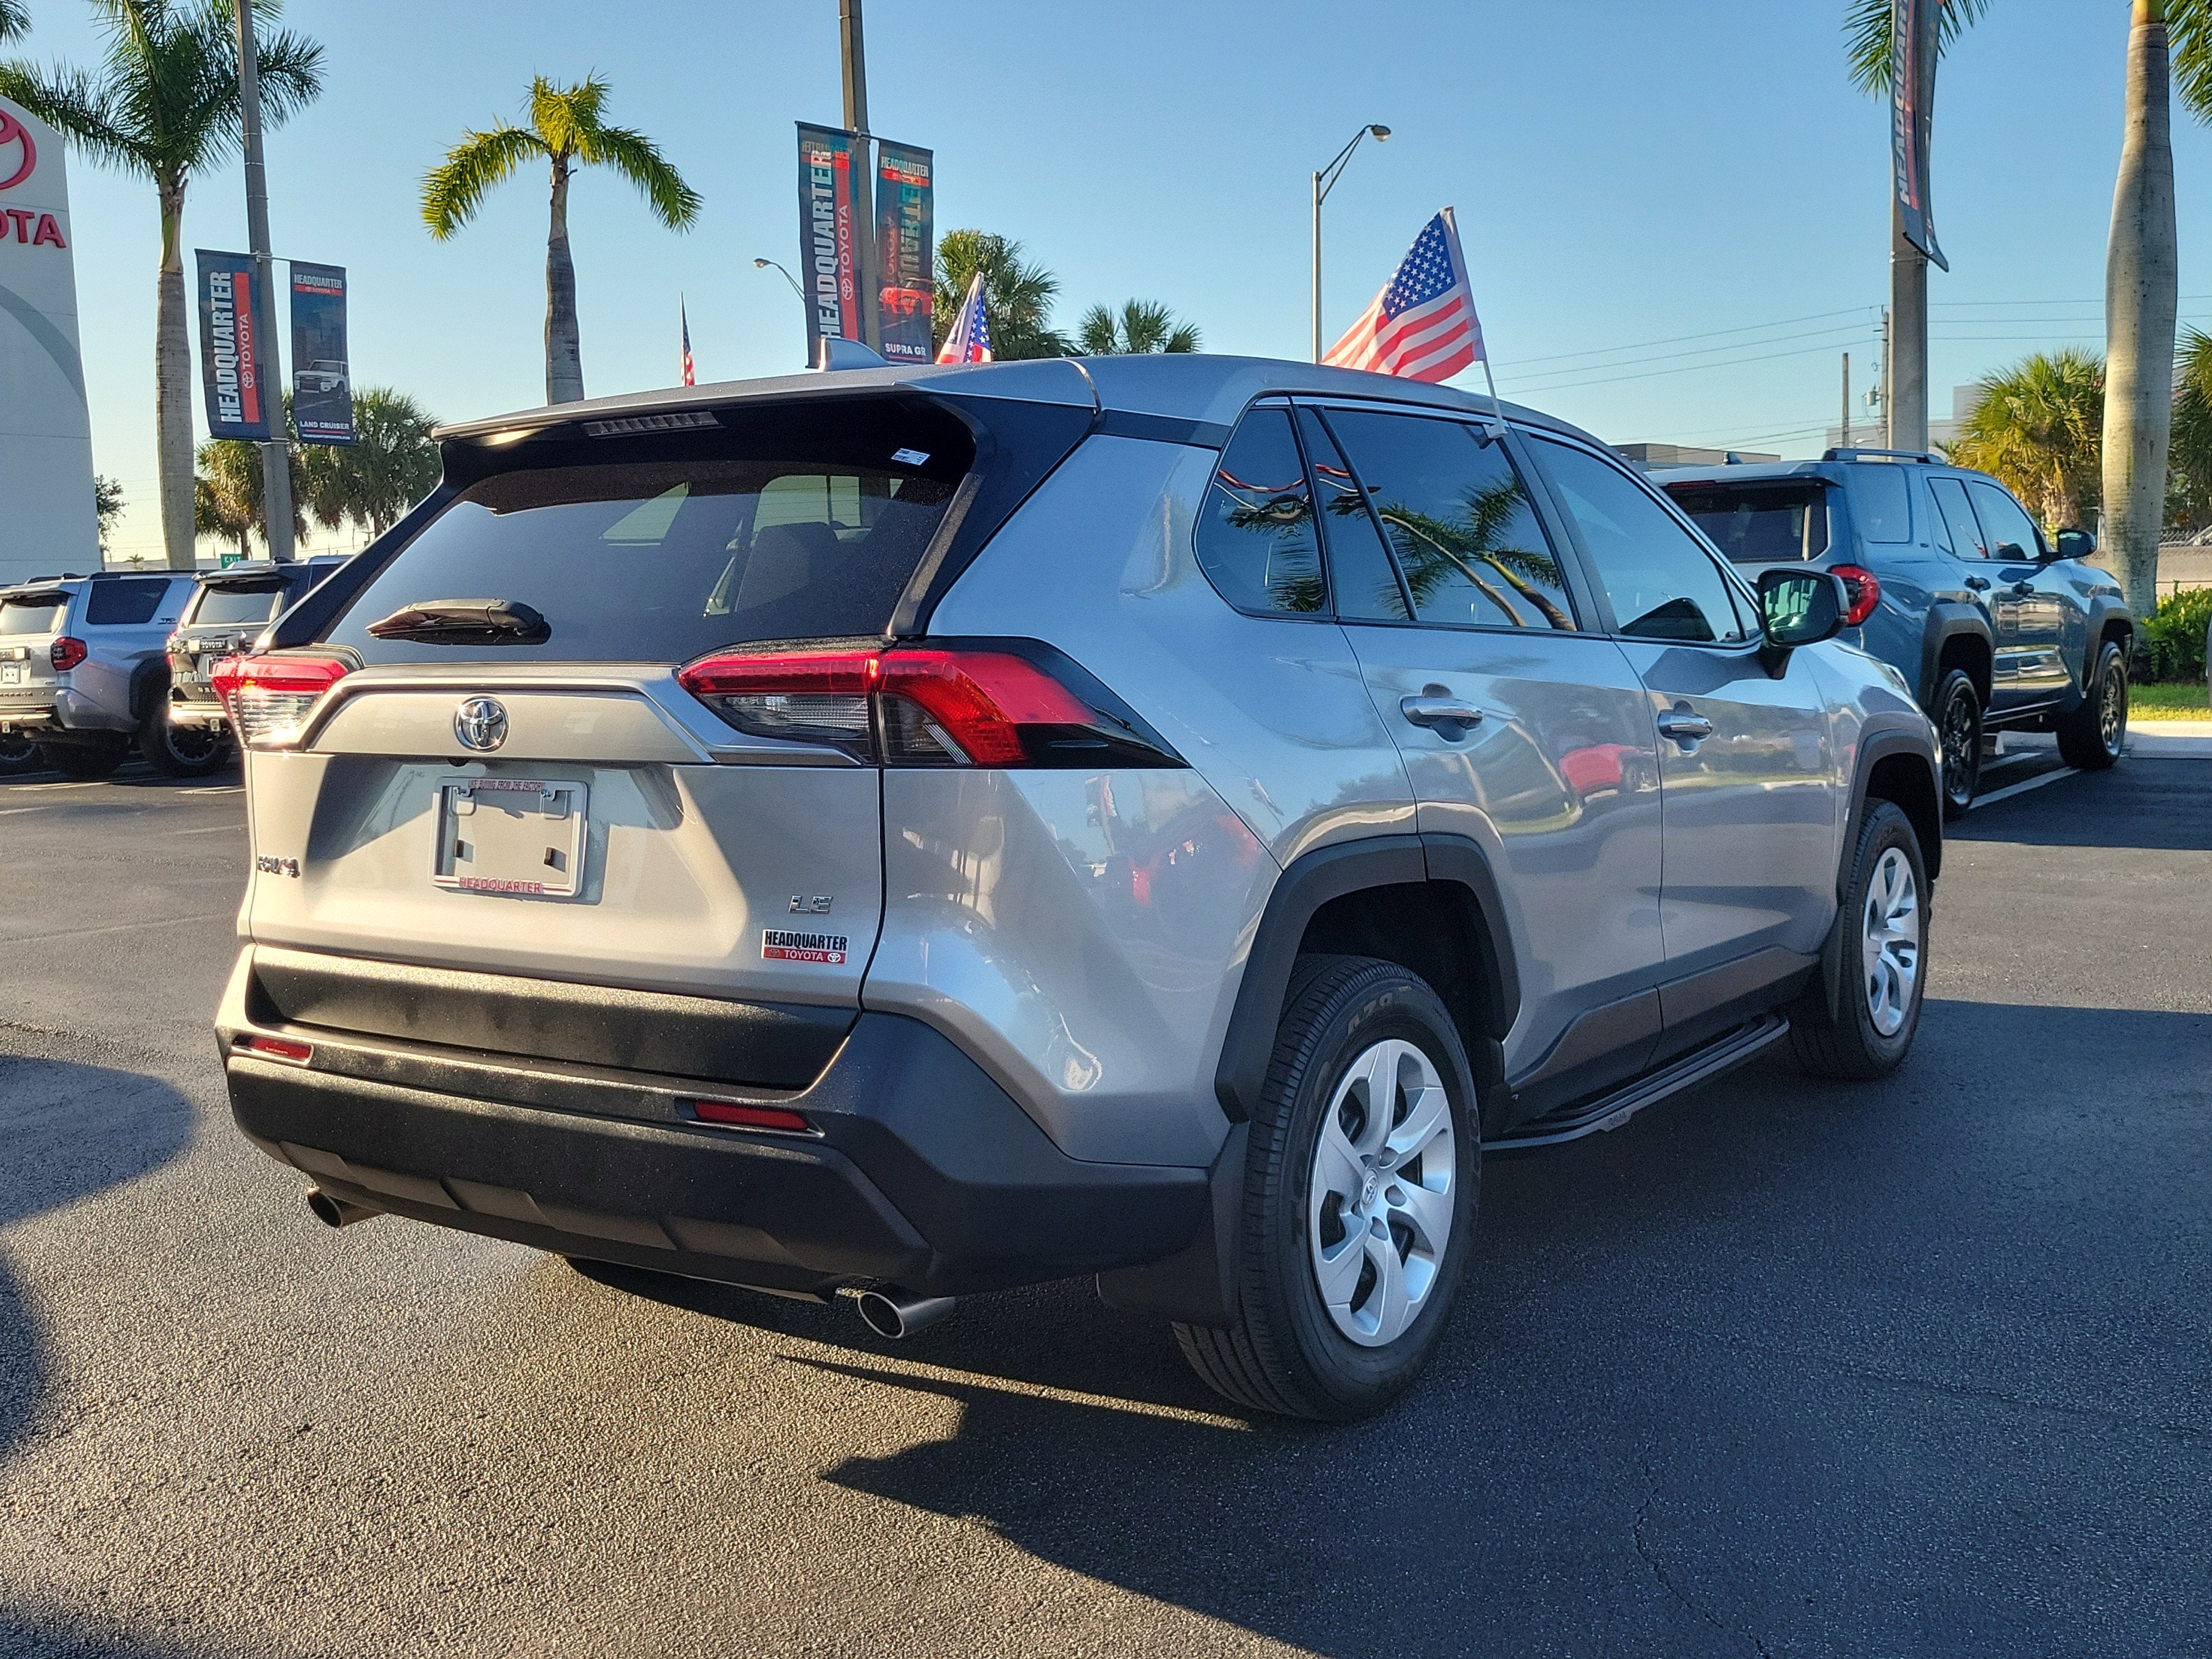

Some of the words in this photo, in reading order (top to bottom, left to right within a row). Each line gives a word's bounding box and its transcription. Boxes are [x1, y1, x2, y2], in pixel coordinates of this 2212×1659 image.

[1894, 0, 1910, 206] HEADQUAR
[881, 156, 929, 177] HEADQUARTER
[811, 150, 841, 338] HEADQUARTER
[838, 205, 850, 275] TOYOTA
[294, 274, 342, 289] HEADQUARTER
[210, 272, 242, 422] HEADQUARTER
[239, 313, 251, 369] TOYOTA
[884, 343, 913, 355] SUPRA
[914, 346, 926, 356] GR
[319, 421, 349, 430] CRUISER
[459, 877, 542, 893] HEADQUARTER
[788, 895, 833, 915] LE
[765, 930, 848, 951] HEADQUARTER
[784, 950, 823, 961] TOYOTA
